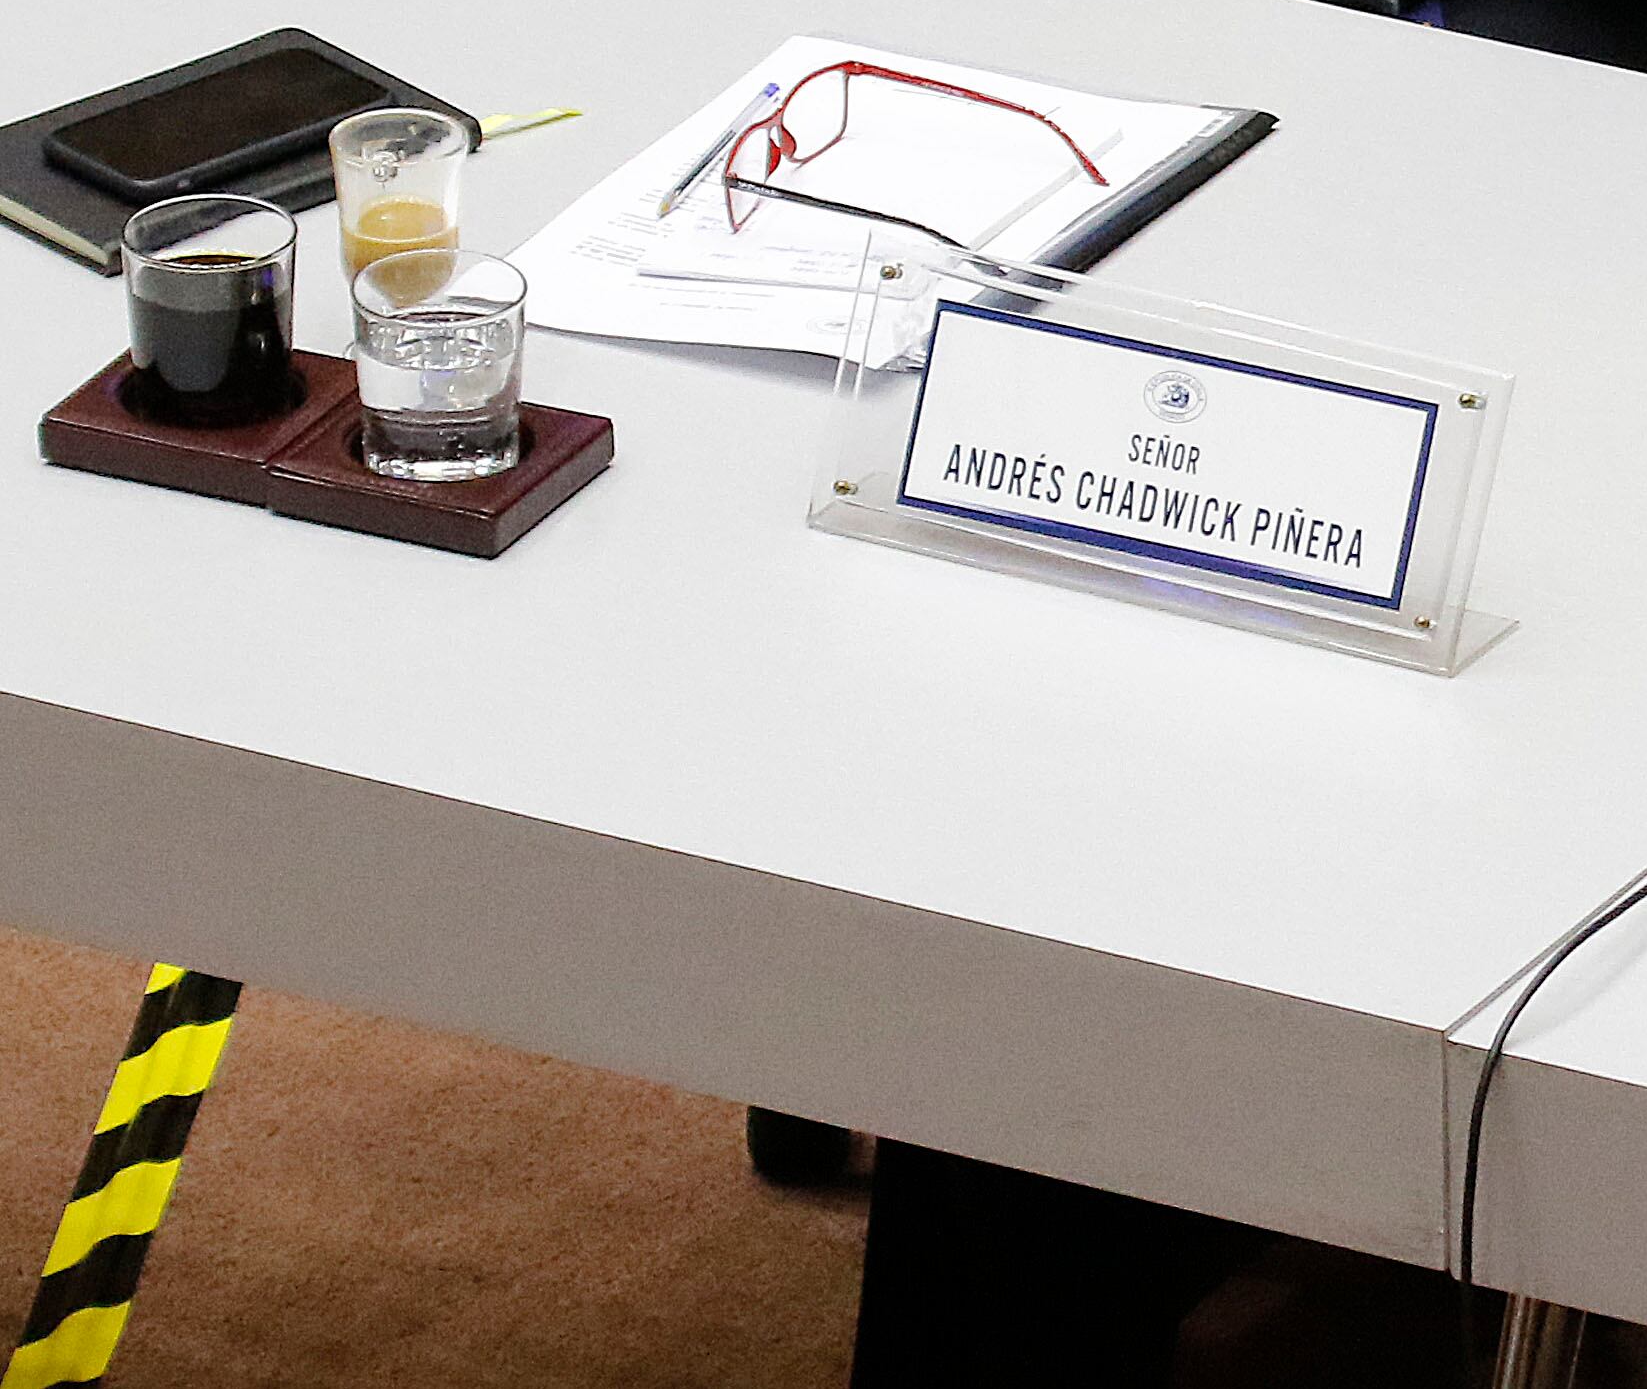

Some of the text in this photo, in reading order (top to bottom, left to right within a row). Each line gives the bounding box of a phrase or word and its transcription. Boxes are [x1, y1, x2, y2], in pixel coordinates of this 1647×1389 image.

[1128, 433, 1200, 475] SEÑOR
[943, 444, 1364, 568] ANDRÉS CHADWICK PIÑERA
